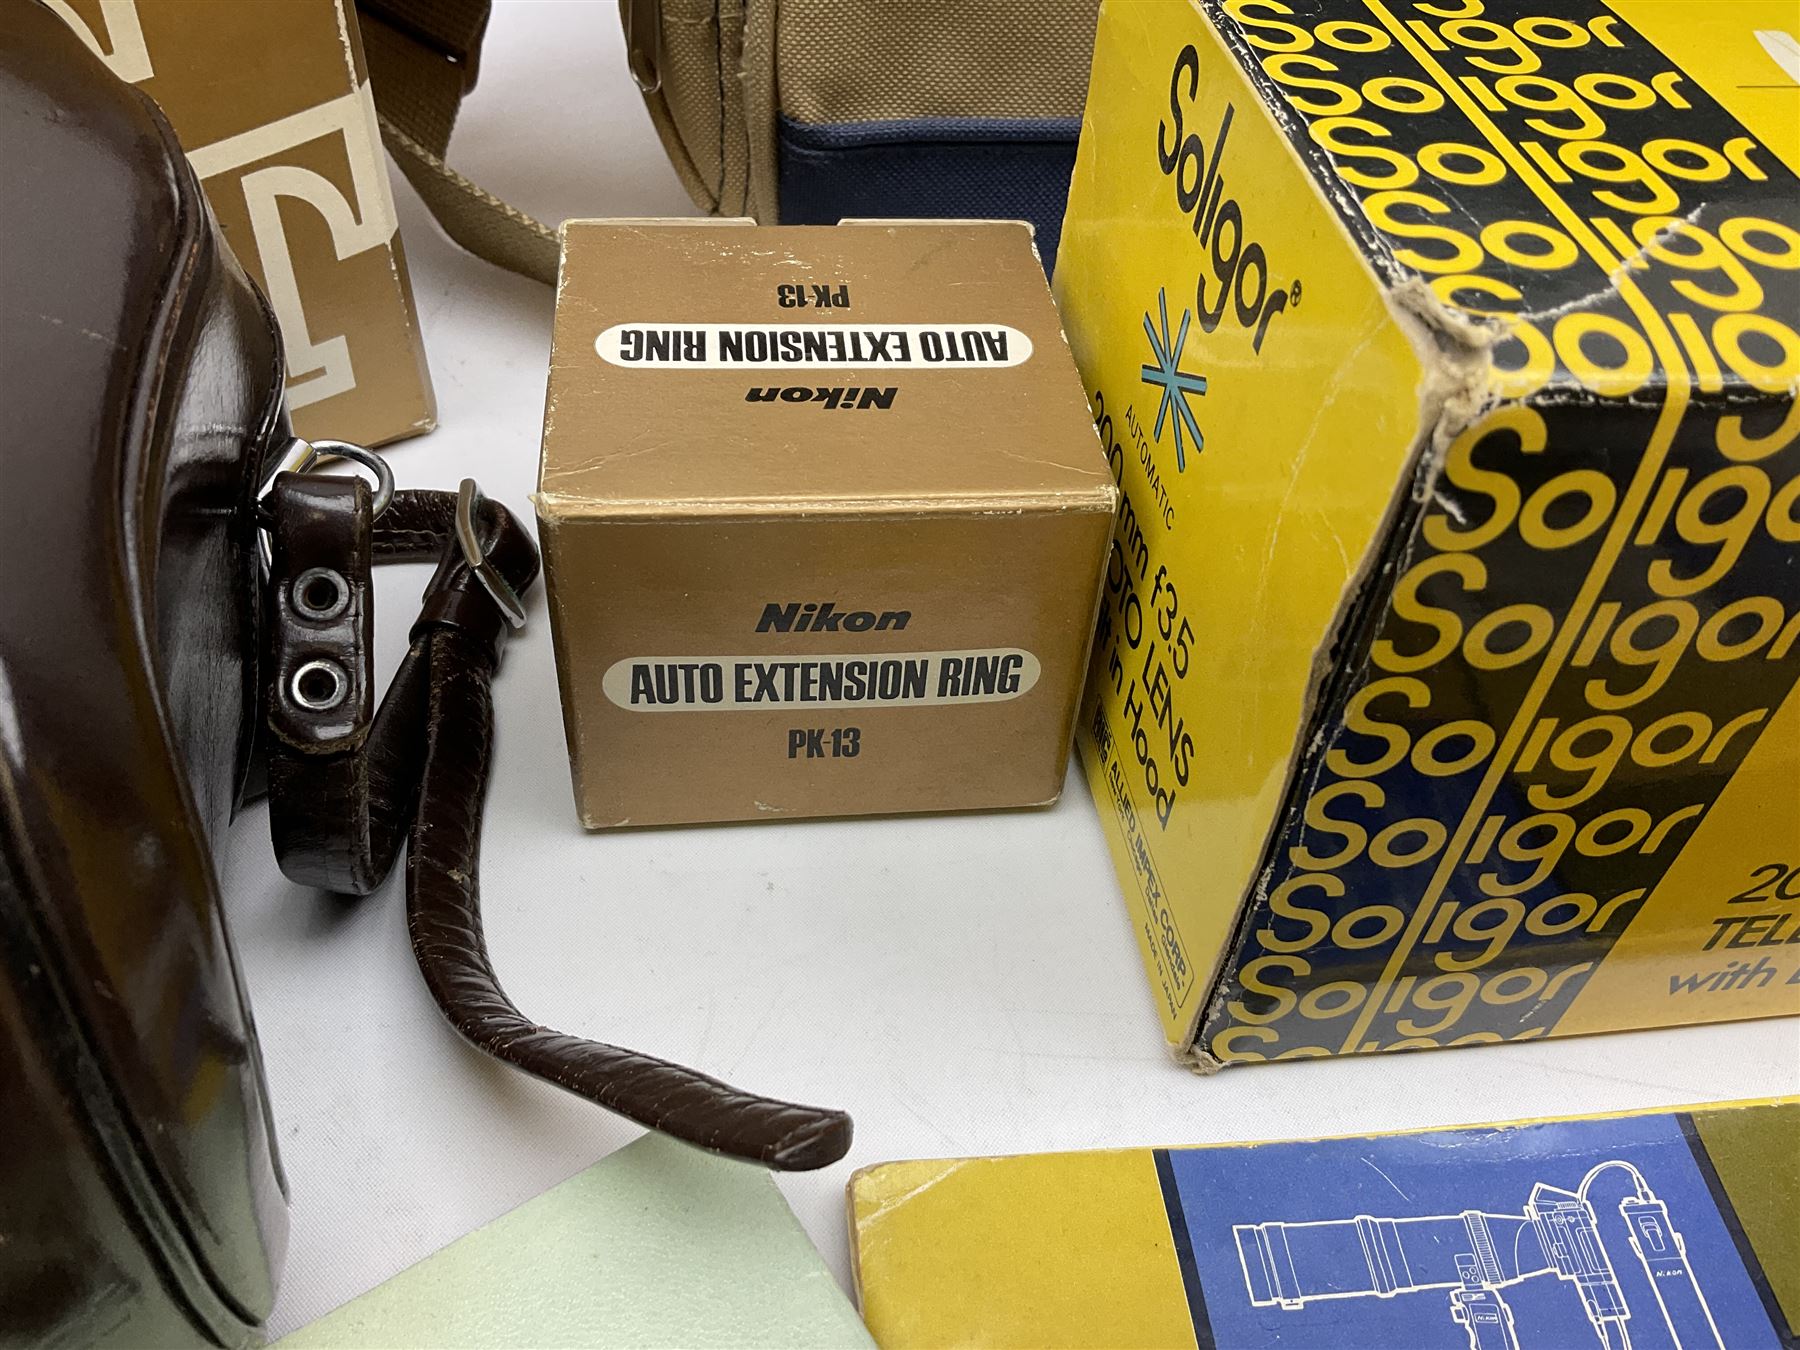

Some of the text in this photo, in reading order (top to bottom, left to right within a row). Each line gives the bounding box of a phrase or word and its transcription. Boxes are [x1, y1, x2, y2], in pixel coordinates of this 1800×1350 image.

[1222, 0, 1624, 75] Soligor
[1262, 54, 1692, 139] Soligor
[1309, 117, 1768, 214] Soligor
[776, 284, 850, 308] PK-13
[620, 329, 1009, 363] AUTO EXTENSION RING
[745, 386, 899, 410] Nikon
[1125, 403, 1175, 531] AUTOMATIC
[754, 602, 912, 634] Nikon
[630, 653, 1023, 706] AUTO EXTENSION RING
[1142, 640, 1195, 787] LENS
[788, 727, 861, 760] PK-13
[1109, 634, 1123, 696] in
[1123, 678, 1176, 832] Hood
[1326, 676, 1769, 811] Soligor
[1110, 760, 1136, 833] ALLIED
[1135, 832, 1161, 908] IMPEX
[1289, 780, 1704, 896] Soligor
[1256, 873, 1646, 971] Soligor
[1144, 922, 1158, 960] MADE
[1162, 981, 1177, 1020] JAPAN
[1227, 955, 1597, 1037] Soligor
[1669, 956, 1779, 996] with
